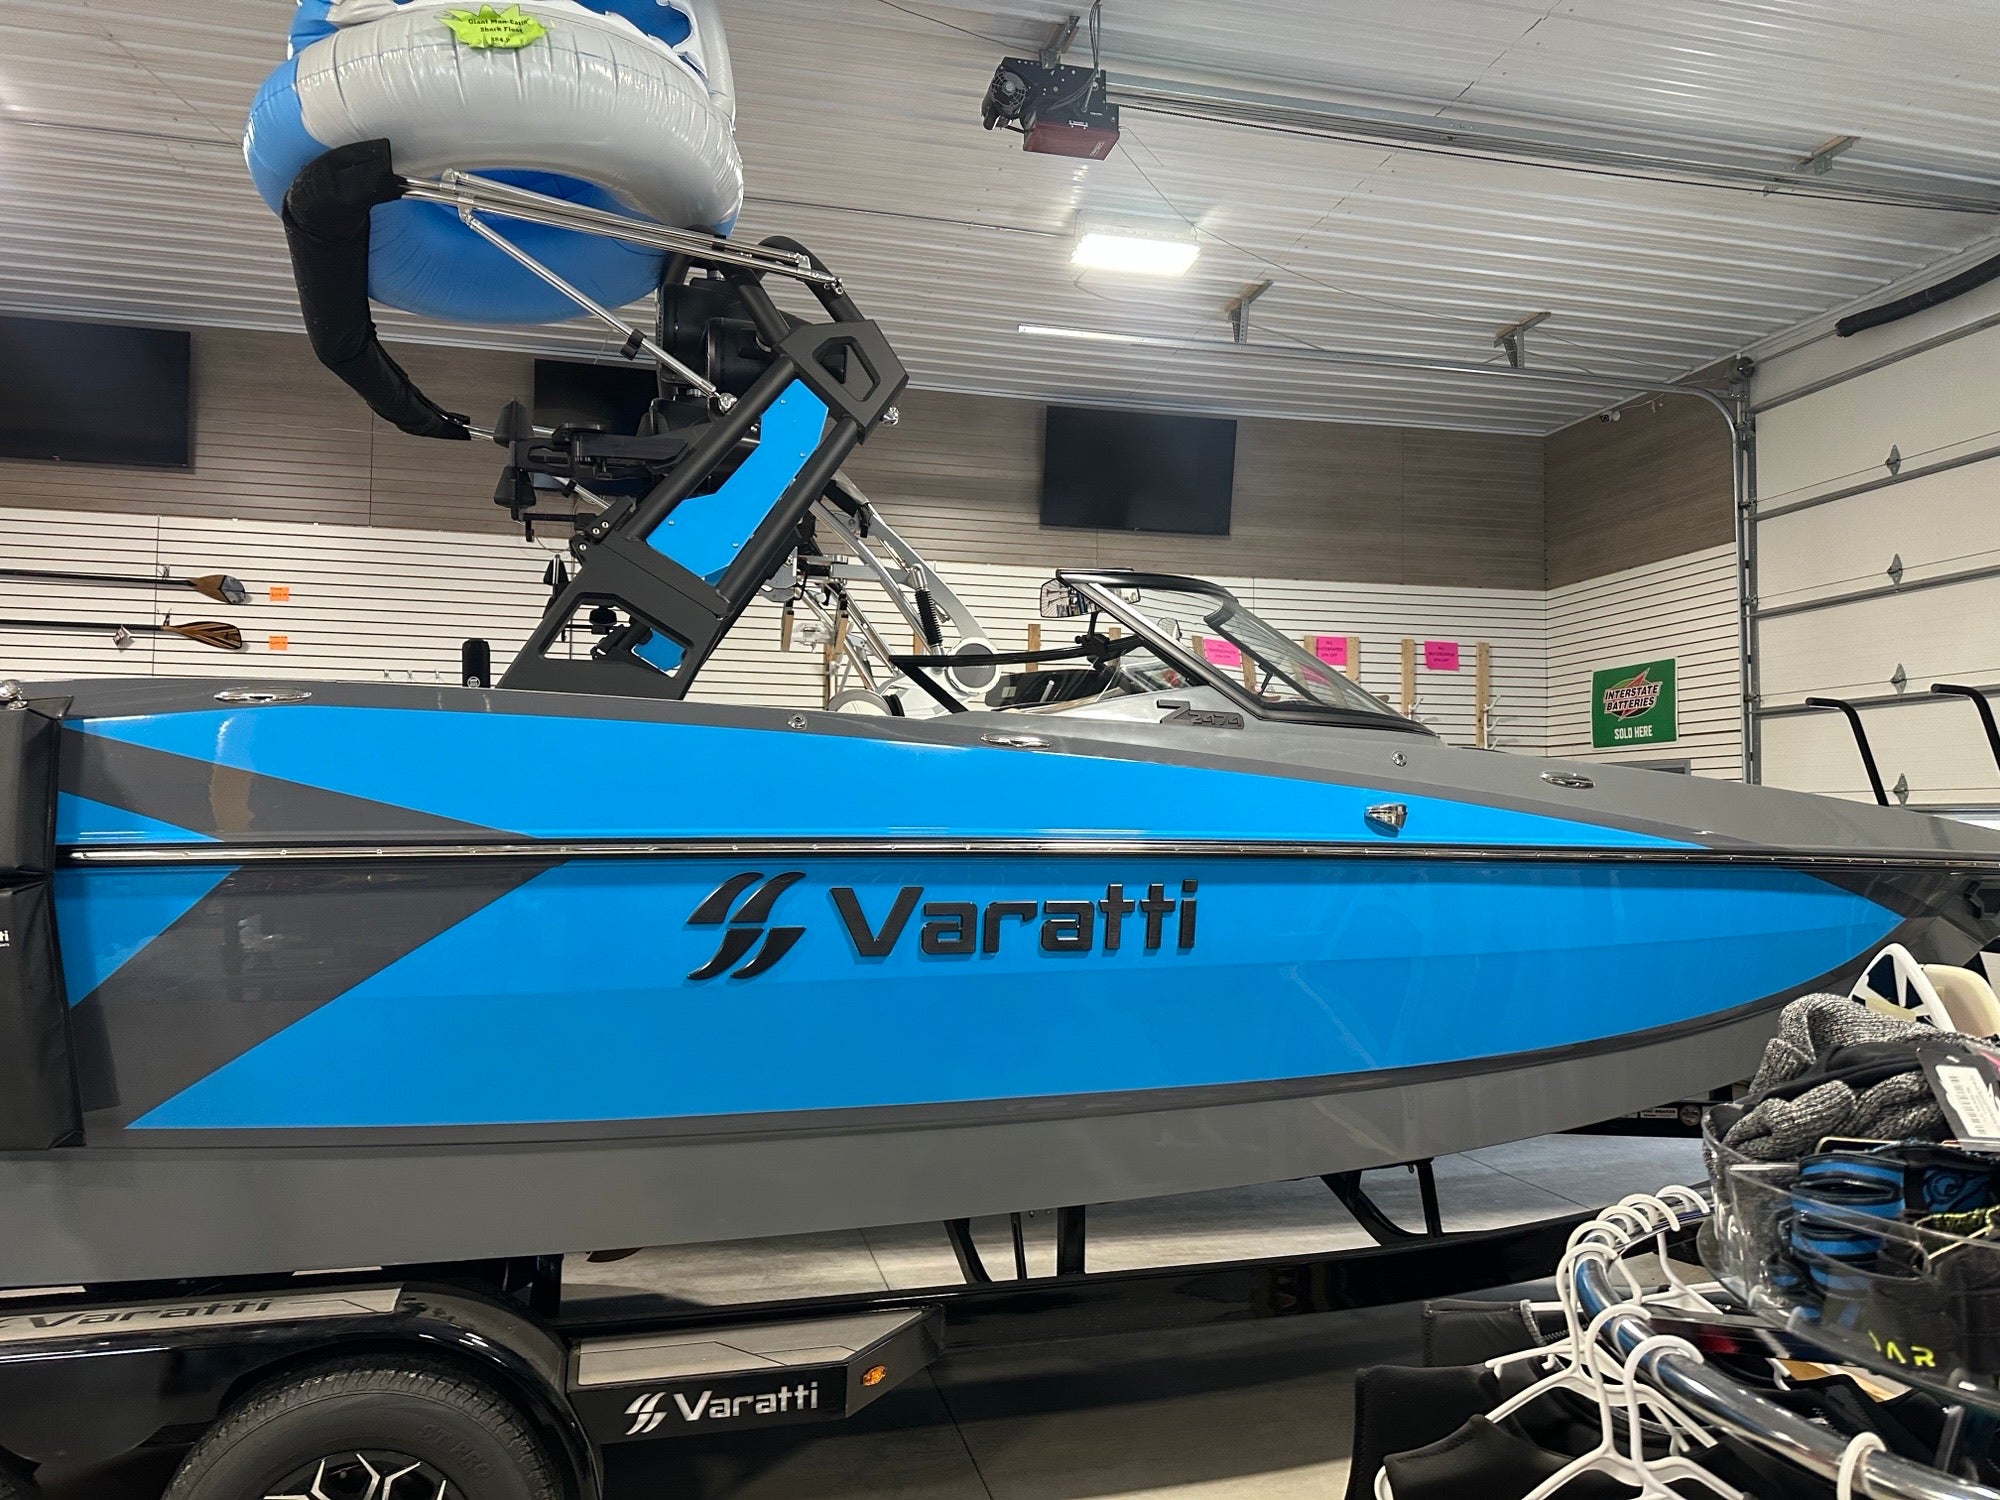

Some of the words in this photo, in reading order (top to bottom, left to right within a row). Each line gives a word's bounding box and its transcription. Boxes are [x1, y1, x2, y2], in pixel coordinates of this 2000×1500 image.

[503, 26, 524, 34] Float
[1605, 684, 1659, 700] INTERSTATE
[1606, 697, 1655, 711] BATTERIES
[1614, 726, 1633, 740] SOLD
[1634, 724, 1653, 738] HERE
[829, 879, 1198, 957] Varatti
[29, 1299, 272, 1329] Varatti
[672, 1381, 819, 1422] Varatti
